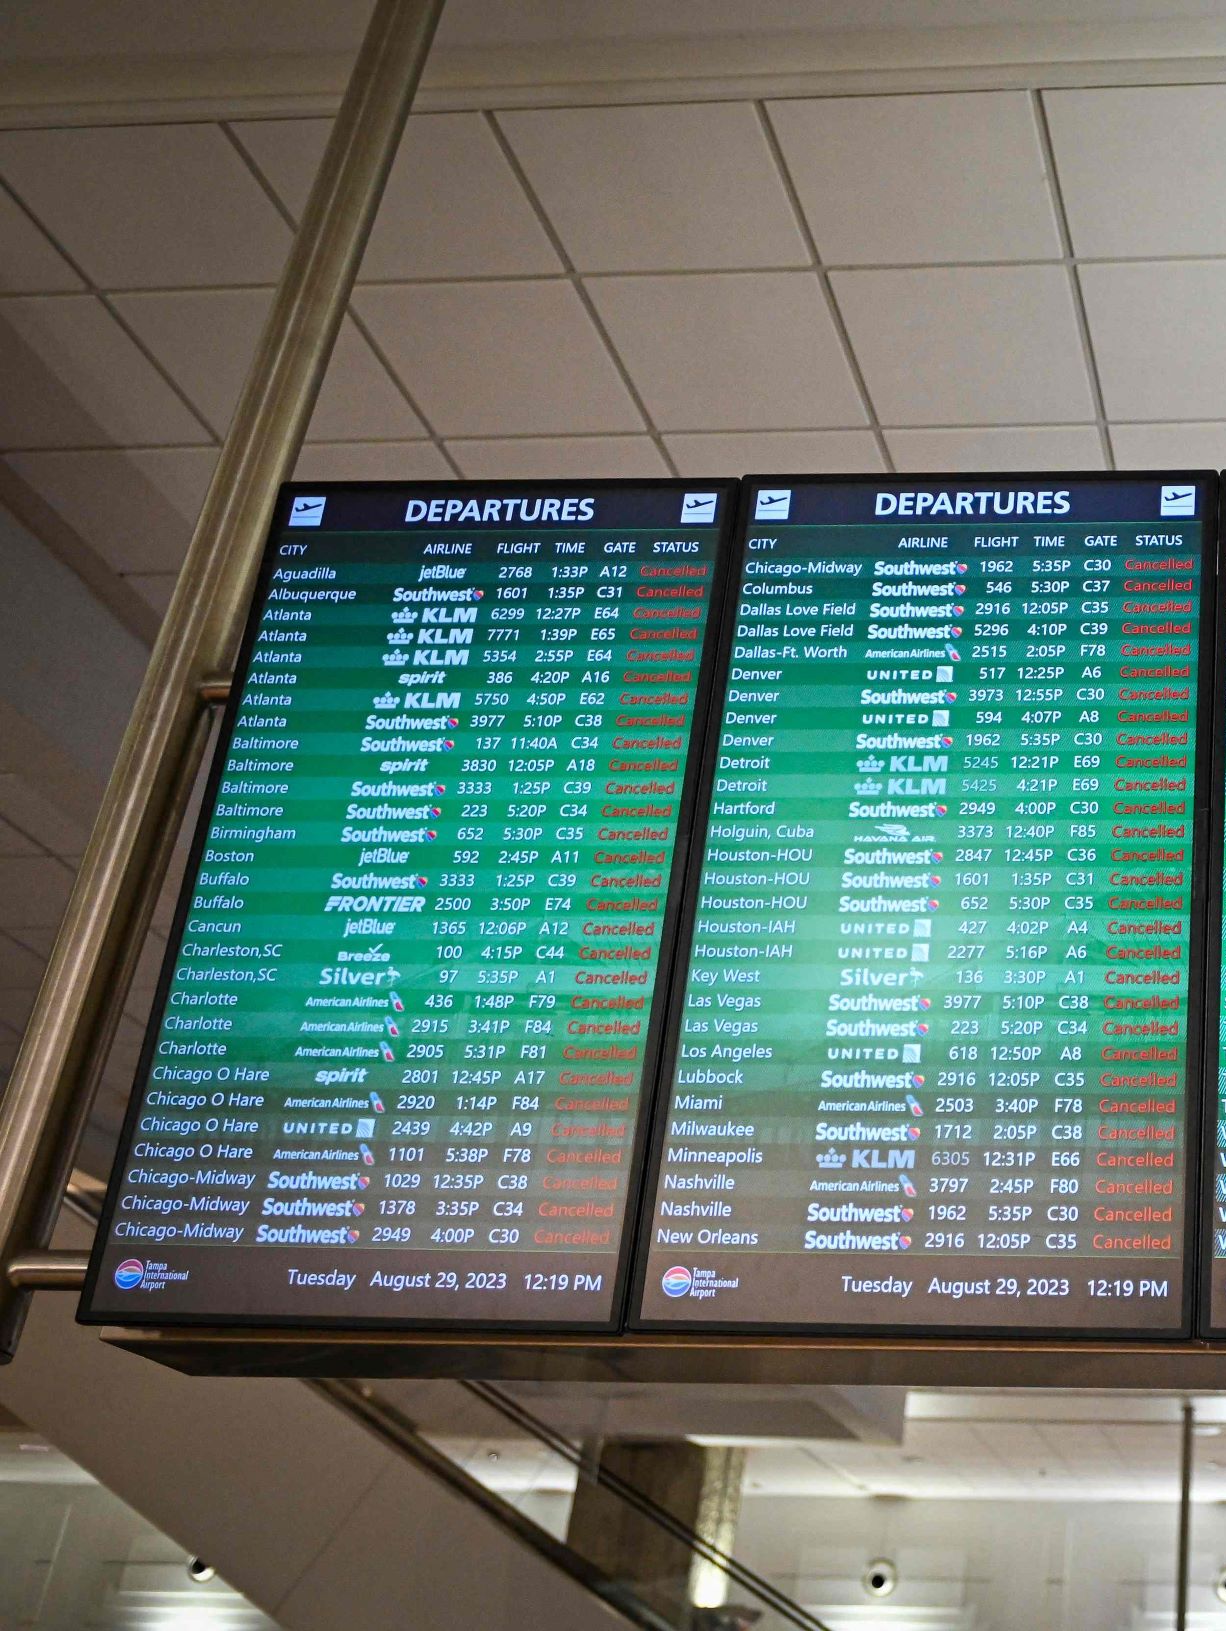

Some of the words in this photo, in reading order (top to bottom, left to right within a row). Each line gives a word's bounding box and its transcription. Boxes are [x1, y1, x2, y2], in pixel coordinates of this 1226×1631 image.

[405, 498, 595, 522] DEPARTURES
[875, 491, 1070, 515] DEPARTURES
[279, 544, 307, 556] CITY
[423, 542, 472, 554] AIRLINE
[496, 541, 541, 554] FLIGHT
[555, 541, 586, 554] TIME
[603, 541, 636, 553] GATE
[653, 541, 700, 553] STATUS
[749, 538, 777, 550] CITY
[898, 536, 949, 549] AIRLINE
[974, 536, 1019, 549] FLIGHT
[1034, 535, 1065, 547] TIME
[1084, 535, 1118, 547] GATE
[1135, 534, 1182, 547] STATUS
[273, 567, 336, 582] Aguadilla
[418, 565, 466, 581] jetBlue
[499, 565, 533, 578] 2768
[552, 565, 588, 578] 1:33P
[600, 565, 627, 577] A12
[640, 564, 707, 578] Cancelled
[743, 582, 813, 595] Columbus
[872, 581, 955, 597] Southwest
[986, 581, 1012, 594] 546
[1031, 580, 1069, 593] 5:30P
[1083, 579, 1111, 592] C37
[1124, 579, 1193, 592] Cancelled
[725, 711, 777, 725] Denver
[863, 713, 929, 725] UNITED
[976, 711, 1002, 724] 594
[1022, 710, 1061, 724] 4:07P
[1079, 710, 1099, 723] A8
[1118, 709, 1188, 723] Cancelled
[216, 803, 284, 818] Baltimore
[346, 804, 432, 821] Southwest
[461, 804, 488, 818] 223
[507, 804, 546, 818] 5:20P
[560, 804, 588, 818] C34
[601, 804, 671, 818] Cancelled
[713, 801, 776, 816] Hartford
[849, 801, 937, 818] Southwest
[959, 801, 996, 816] 2949
[1015, 801, 1056, 816] 4:00P
[1070, 801, 1099, 815] C30
[1113, 801, 1186, 816] Cancelled
[188, 919, 241, 934] Cancun
[344, 918, 395, 937] jetBlue
[432, 921, 466, 935] 1365
[479, 921, 527, 936] 12:06P
[539, 921, 569, 936] A12
[583, 922, 655, 936] Cancelled
[127, 1168, 256, 1191] Chicago-Midway
[267, 1171, 358, 1191] Southwest
[384, 1173, 421, 1189] 1029
[433, 1174, 484, 1190] 12:35P
[497, 1175, 528, 1190] C38
[543, 1175, 617, 1191] Cancelled
[661, 1201, 731, 1218] Nashville
[808, 1203, 902, 1223] Southwest
[928, 1205, 966, 1221] 1962
[988, 1205, 1032, 1221] 5:35P
[1047, 1205, 1078, 1222] C30
[1094, 1206, 1172, 1222] Cancelled
[145, 1260, 168, 1272] Tampa
[144, 1270, 188, 1281] International
[288, 1270, 356, 1291] Tuesday
[370, 1270, 430, 1291] August
[436, 1272, 459, 1291] 29,
[467, 1273, 507, 1289] 2023
[524, 1273, 569, 1290] 12:19
[574, 1274, 602, 1291] PM
[140, 1280, 166, 1291] Airport
[842, 1275, 913, 1297] Tuesday
[928, 1277, 991, 1299] August
[997, 1278, 1020, 1298] 29,
[1027, 1279, 1070, 1296] 2023
[1088, 1280, 1134, 1298] 12:19
[1139, 1281, 1168, 1298] PM
